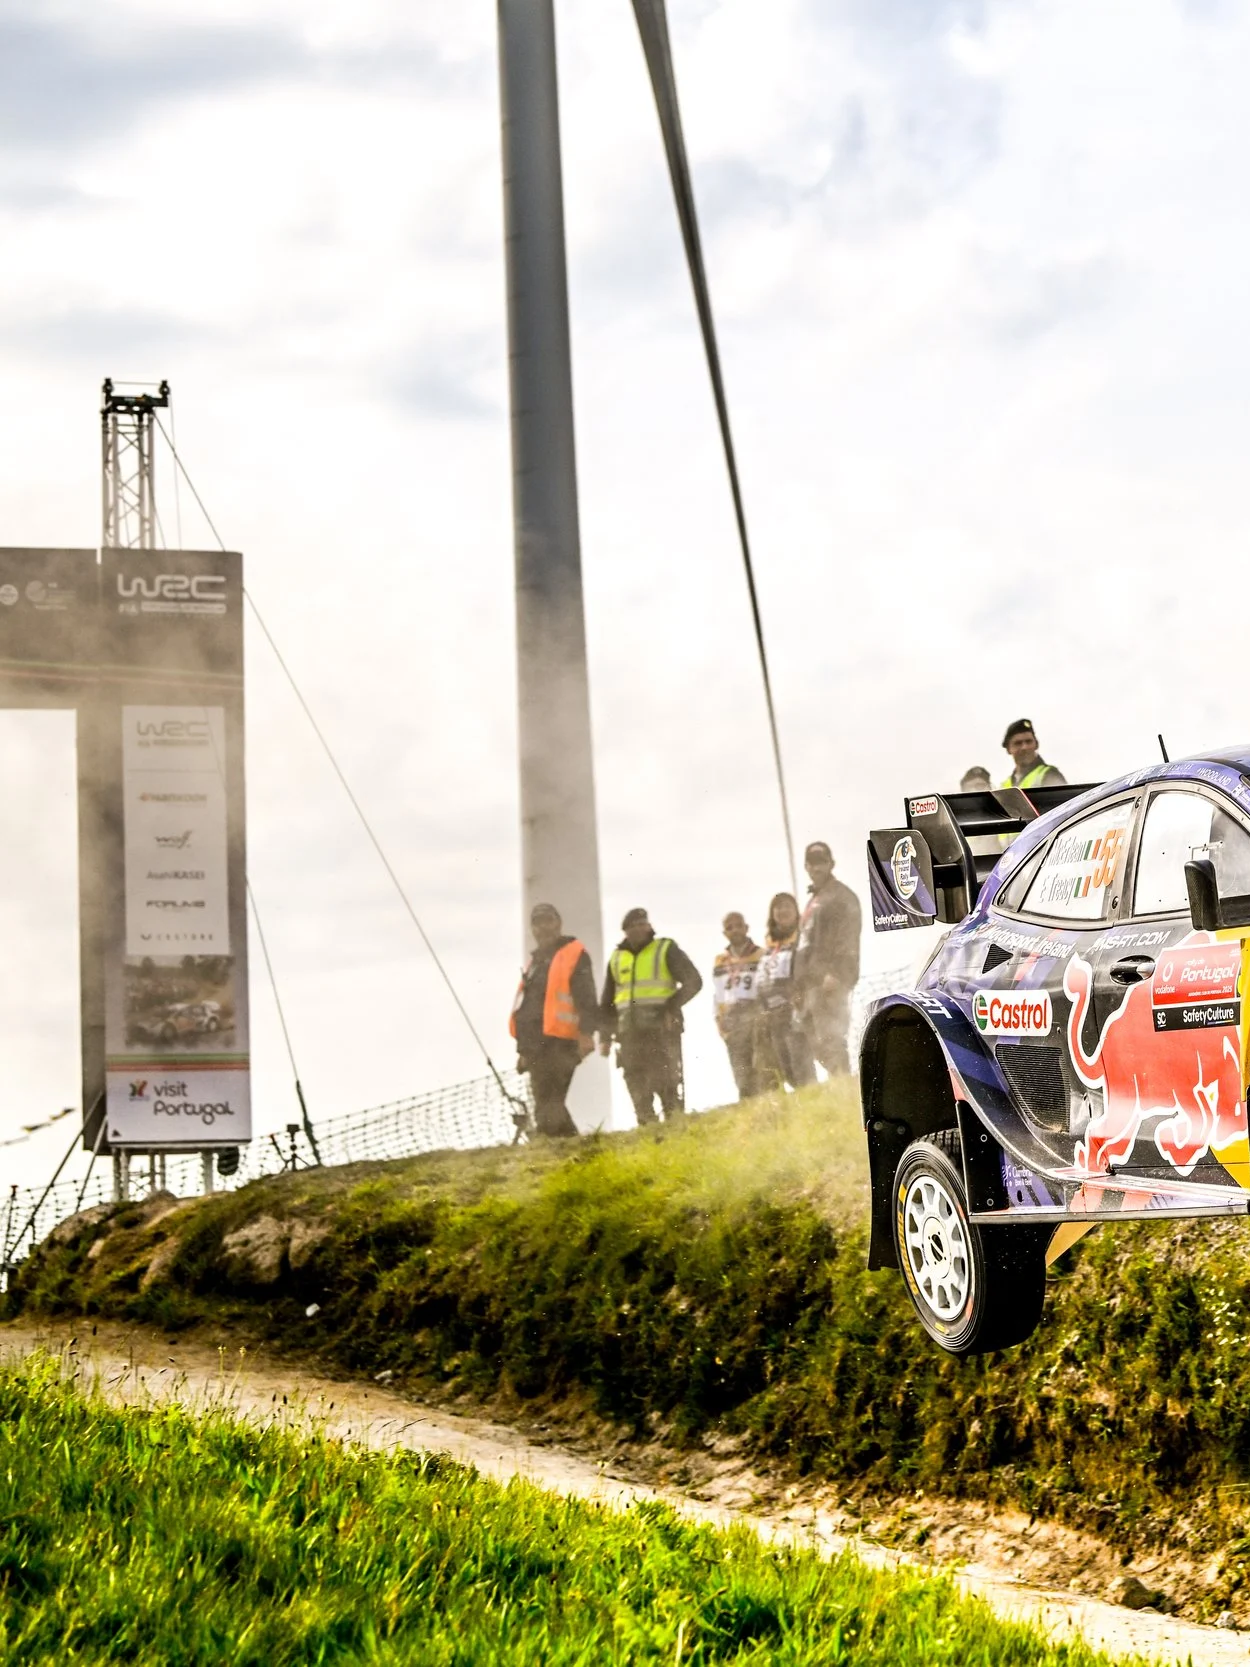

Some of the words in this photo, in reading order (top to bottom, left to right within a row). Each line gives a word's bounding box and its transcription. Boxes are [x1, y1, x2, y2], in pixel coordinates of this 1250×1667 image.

[117, 572, 226, 599] WRC
[137, 720, 209, 738] WRC
[915, 800, 937, 814] Castrol
[1093, 828, 1126, 889] 55
[1038, 936, 1076, 959] Ireland
[1180, 962, 1236, 983] Portugal
[1155, 984, 1176, 995] vodafone
[989, 998, 1048, 1030] Castrol
[1183, 1006, 1234, 1025] SafetyCulture
[153, 1080, 188, 1097] visit
[153, 1100, 235, 1126] Portugal
